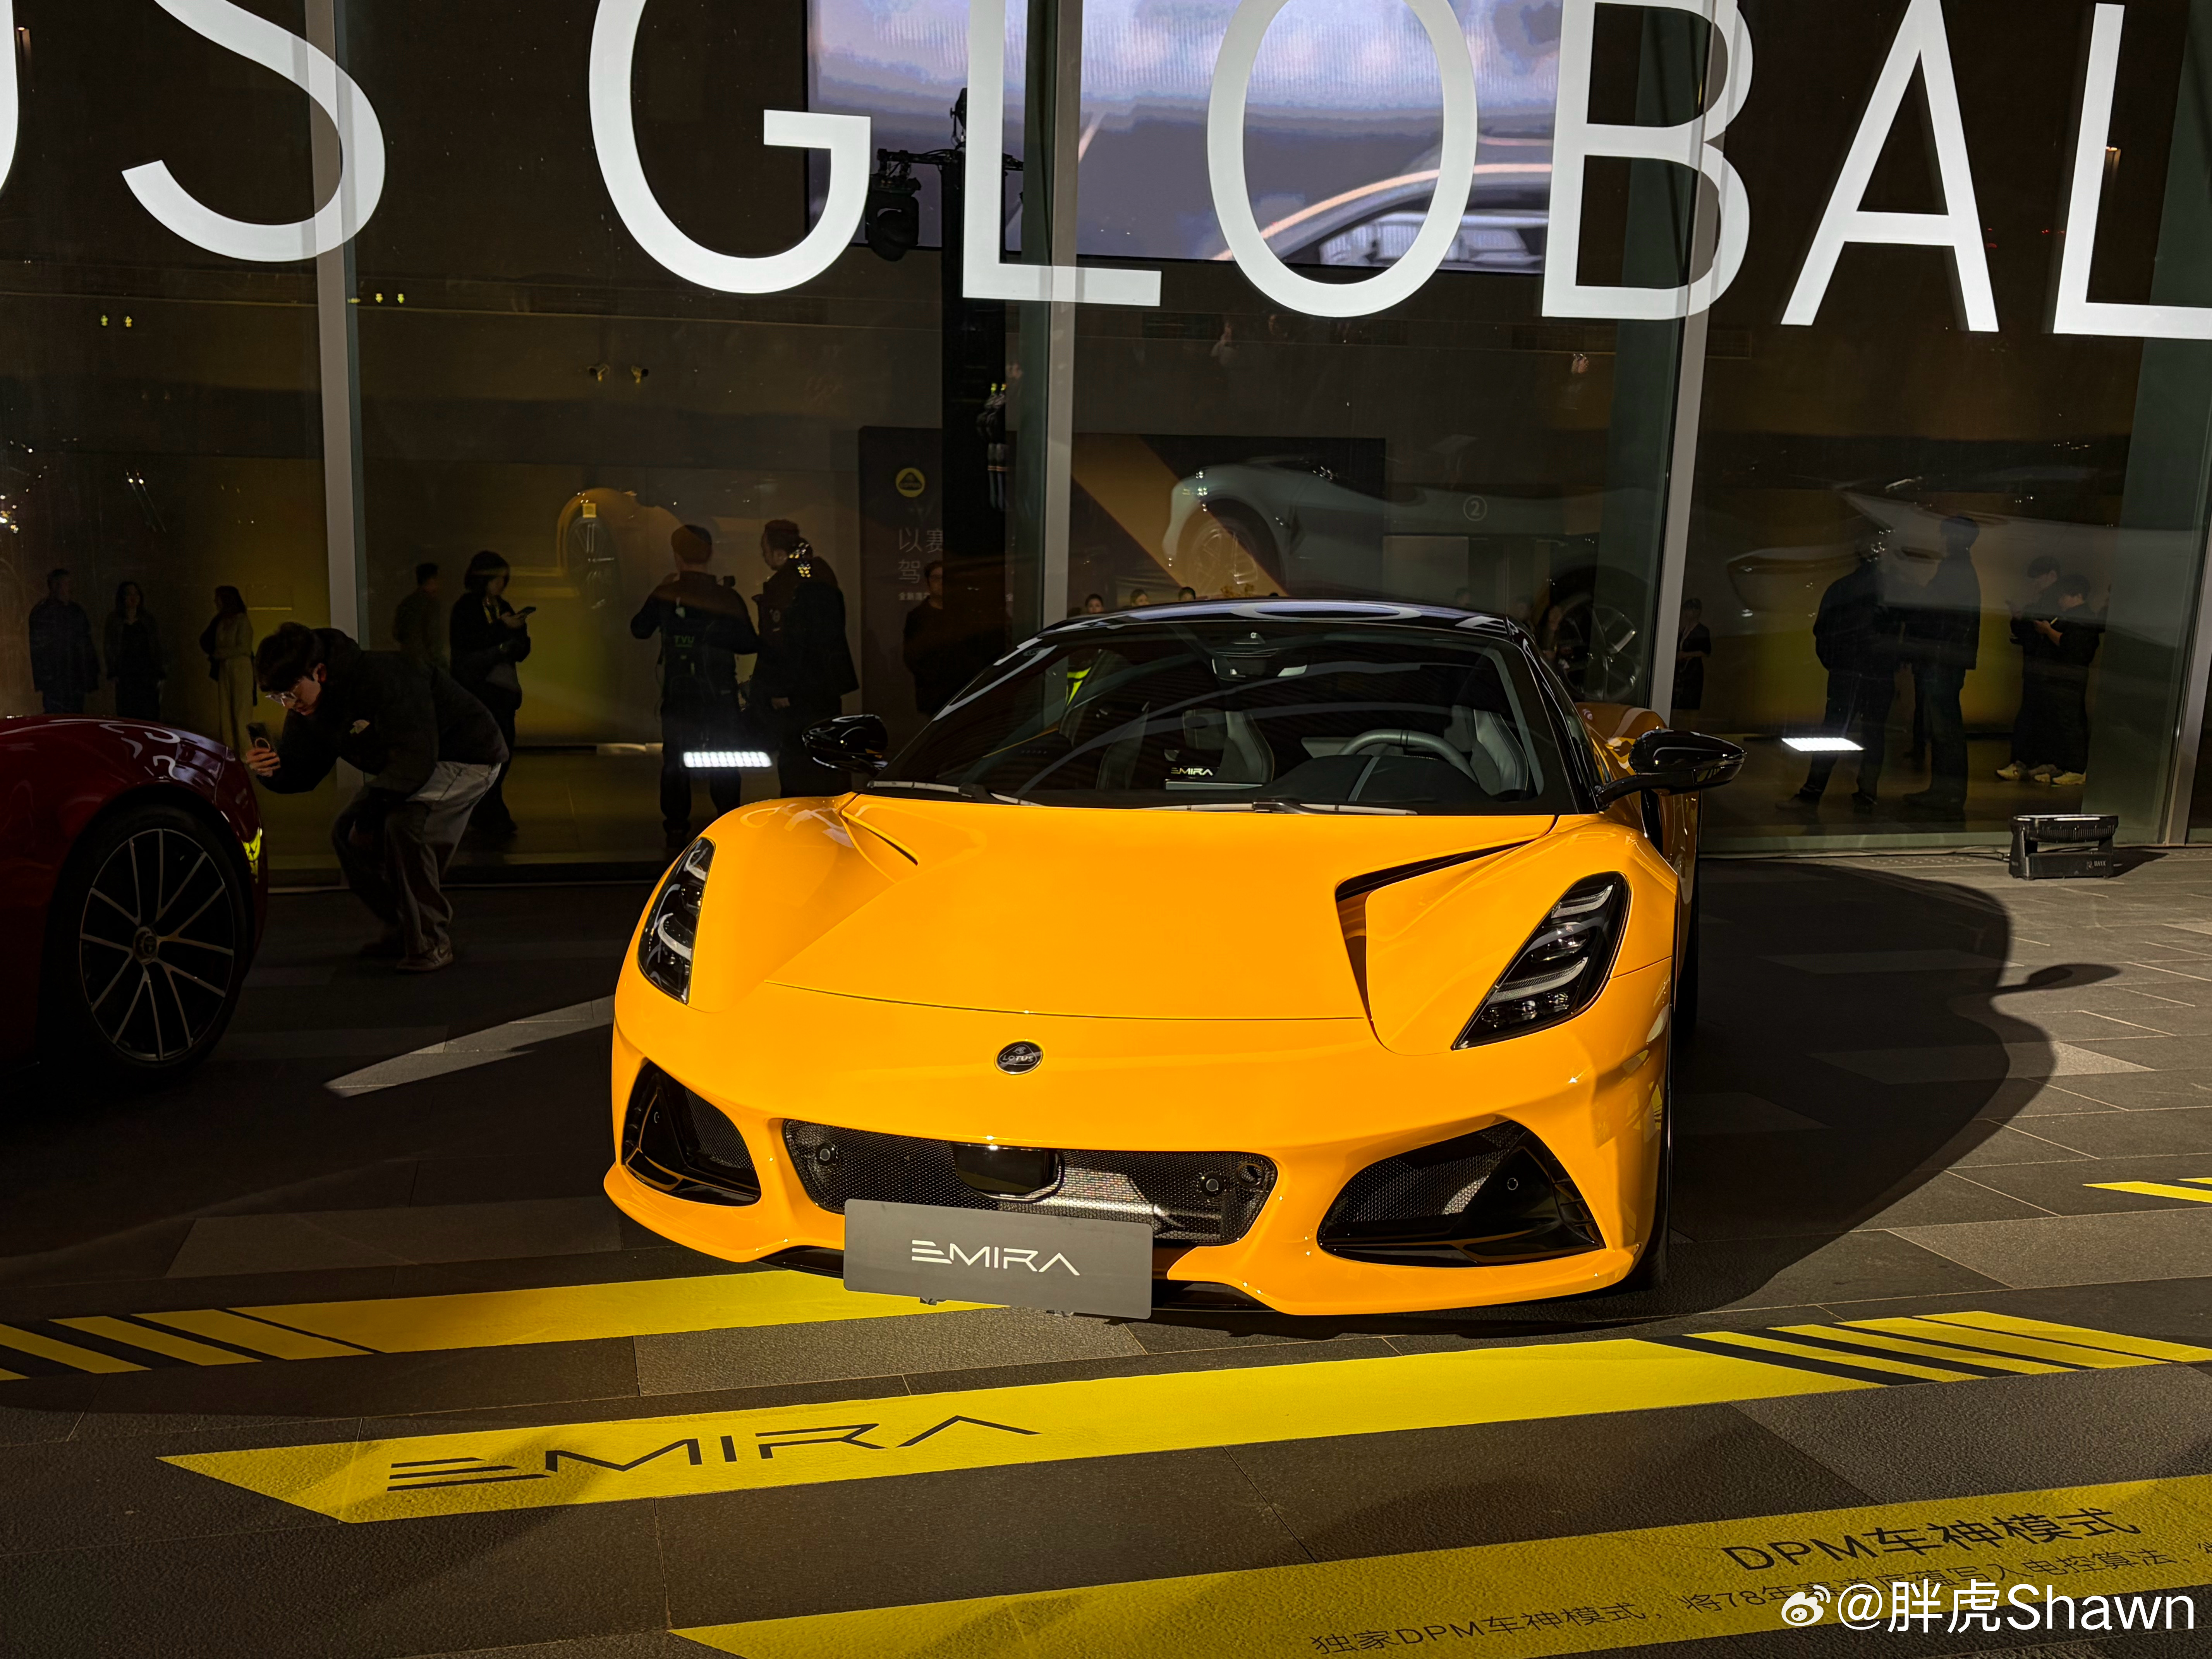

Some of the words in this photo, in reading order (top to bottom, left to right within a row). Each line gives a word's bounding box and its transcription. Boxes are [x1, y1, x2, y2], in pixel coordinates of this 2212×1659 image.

[0, 0, 385, 262] S
[589, 0, 2212, 340] GLOBAL
[1171, 767, 1214, 776] EMIRA
[911, 1240, 1080, 1276] EMIRA
[386, 1415, 1042, 1491] EMIRA
[1721, 1508, 2141, 1571] DPM车神模式
